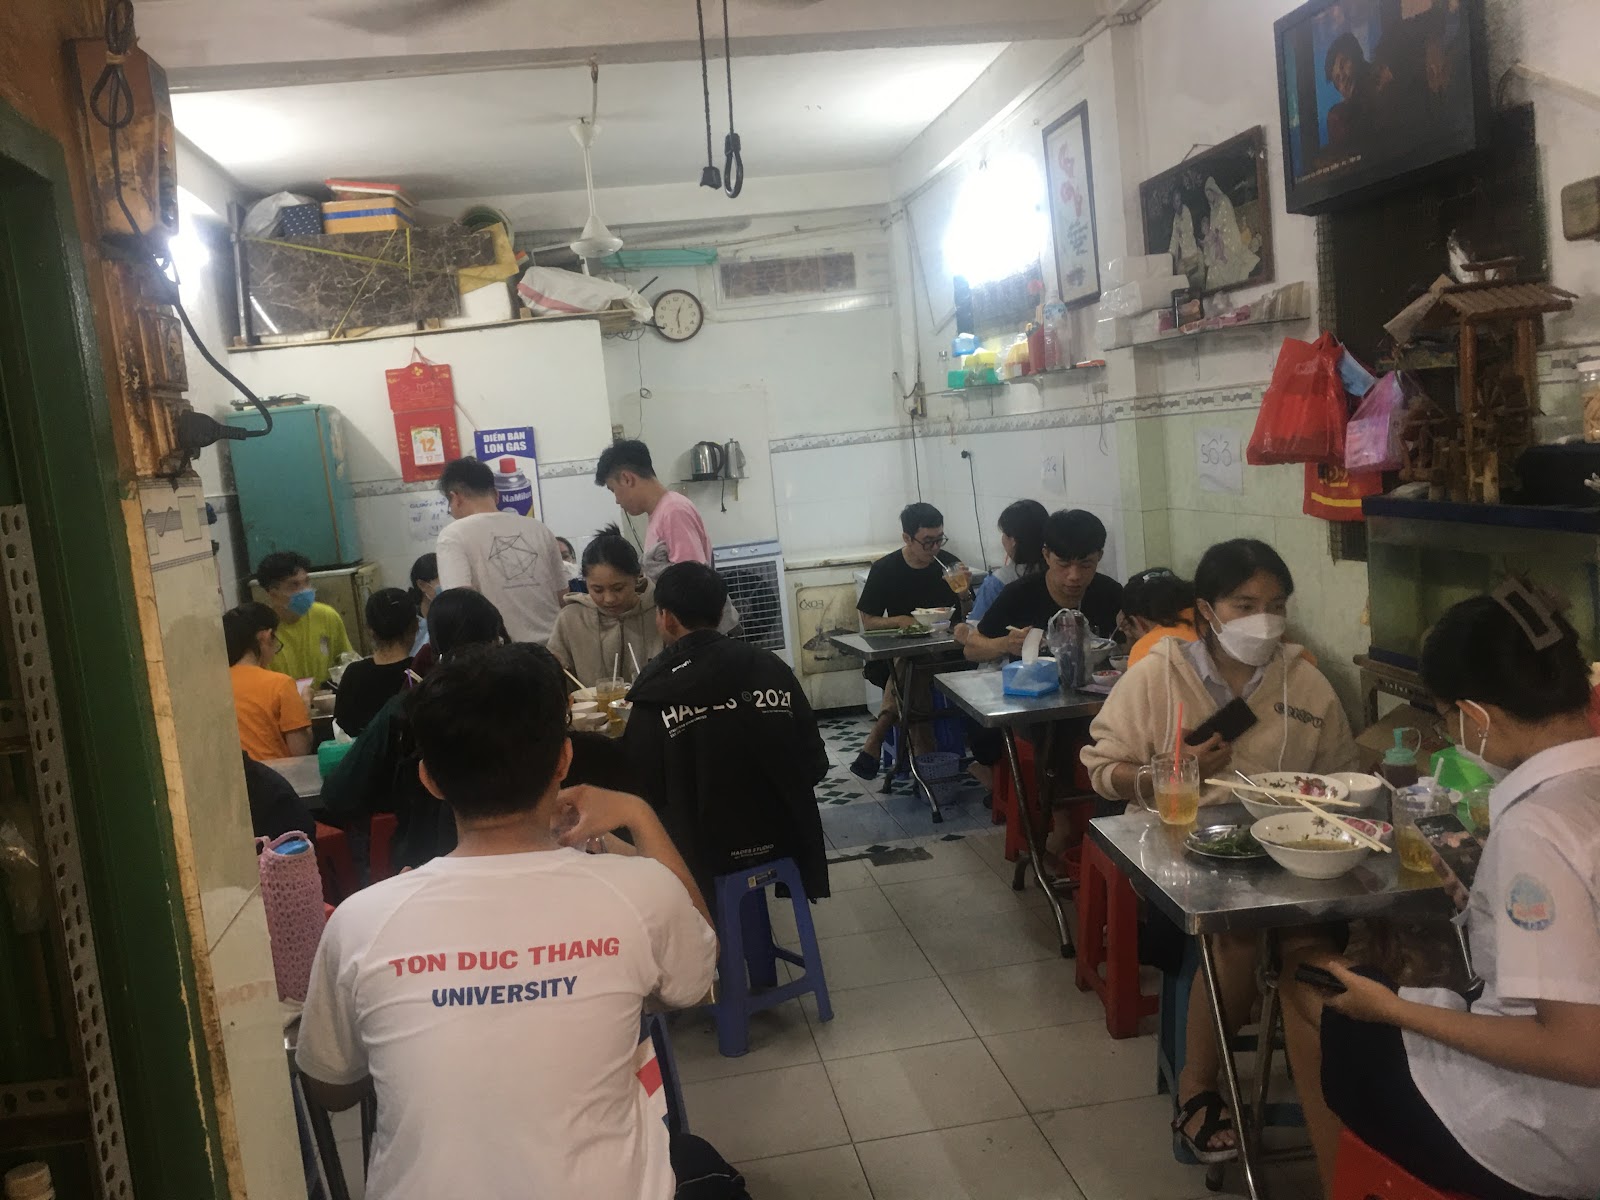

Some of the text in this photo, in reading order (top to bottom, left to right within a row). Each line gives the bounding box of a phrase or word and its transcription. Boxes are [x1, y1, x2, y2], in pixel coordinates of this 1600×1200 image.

[419, 437, 436, 453] 12
[484, 441, 527, 454] LON GAS
[661, 698, 738, 729] HAS
[752, 688, 792, 708] 2021
[388, 937, 620, 977] TON DUC THANG
[431, 975, 578, 1007] UNIVERSITY
